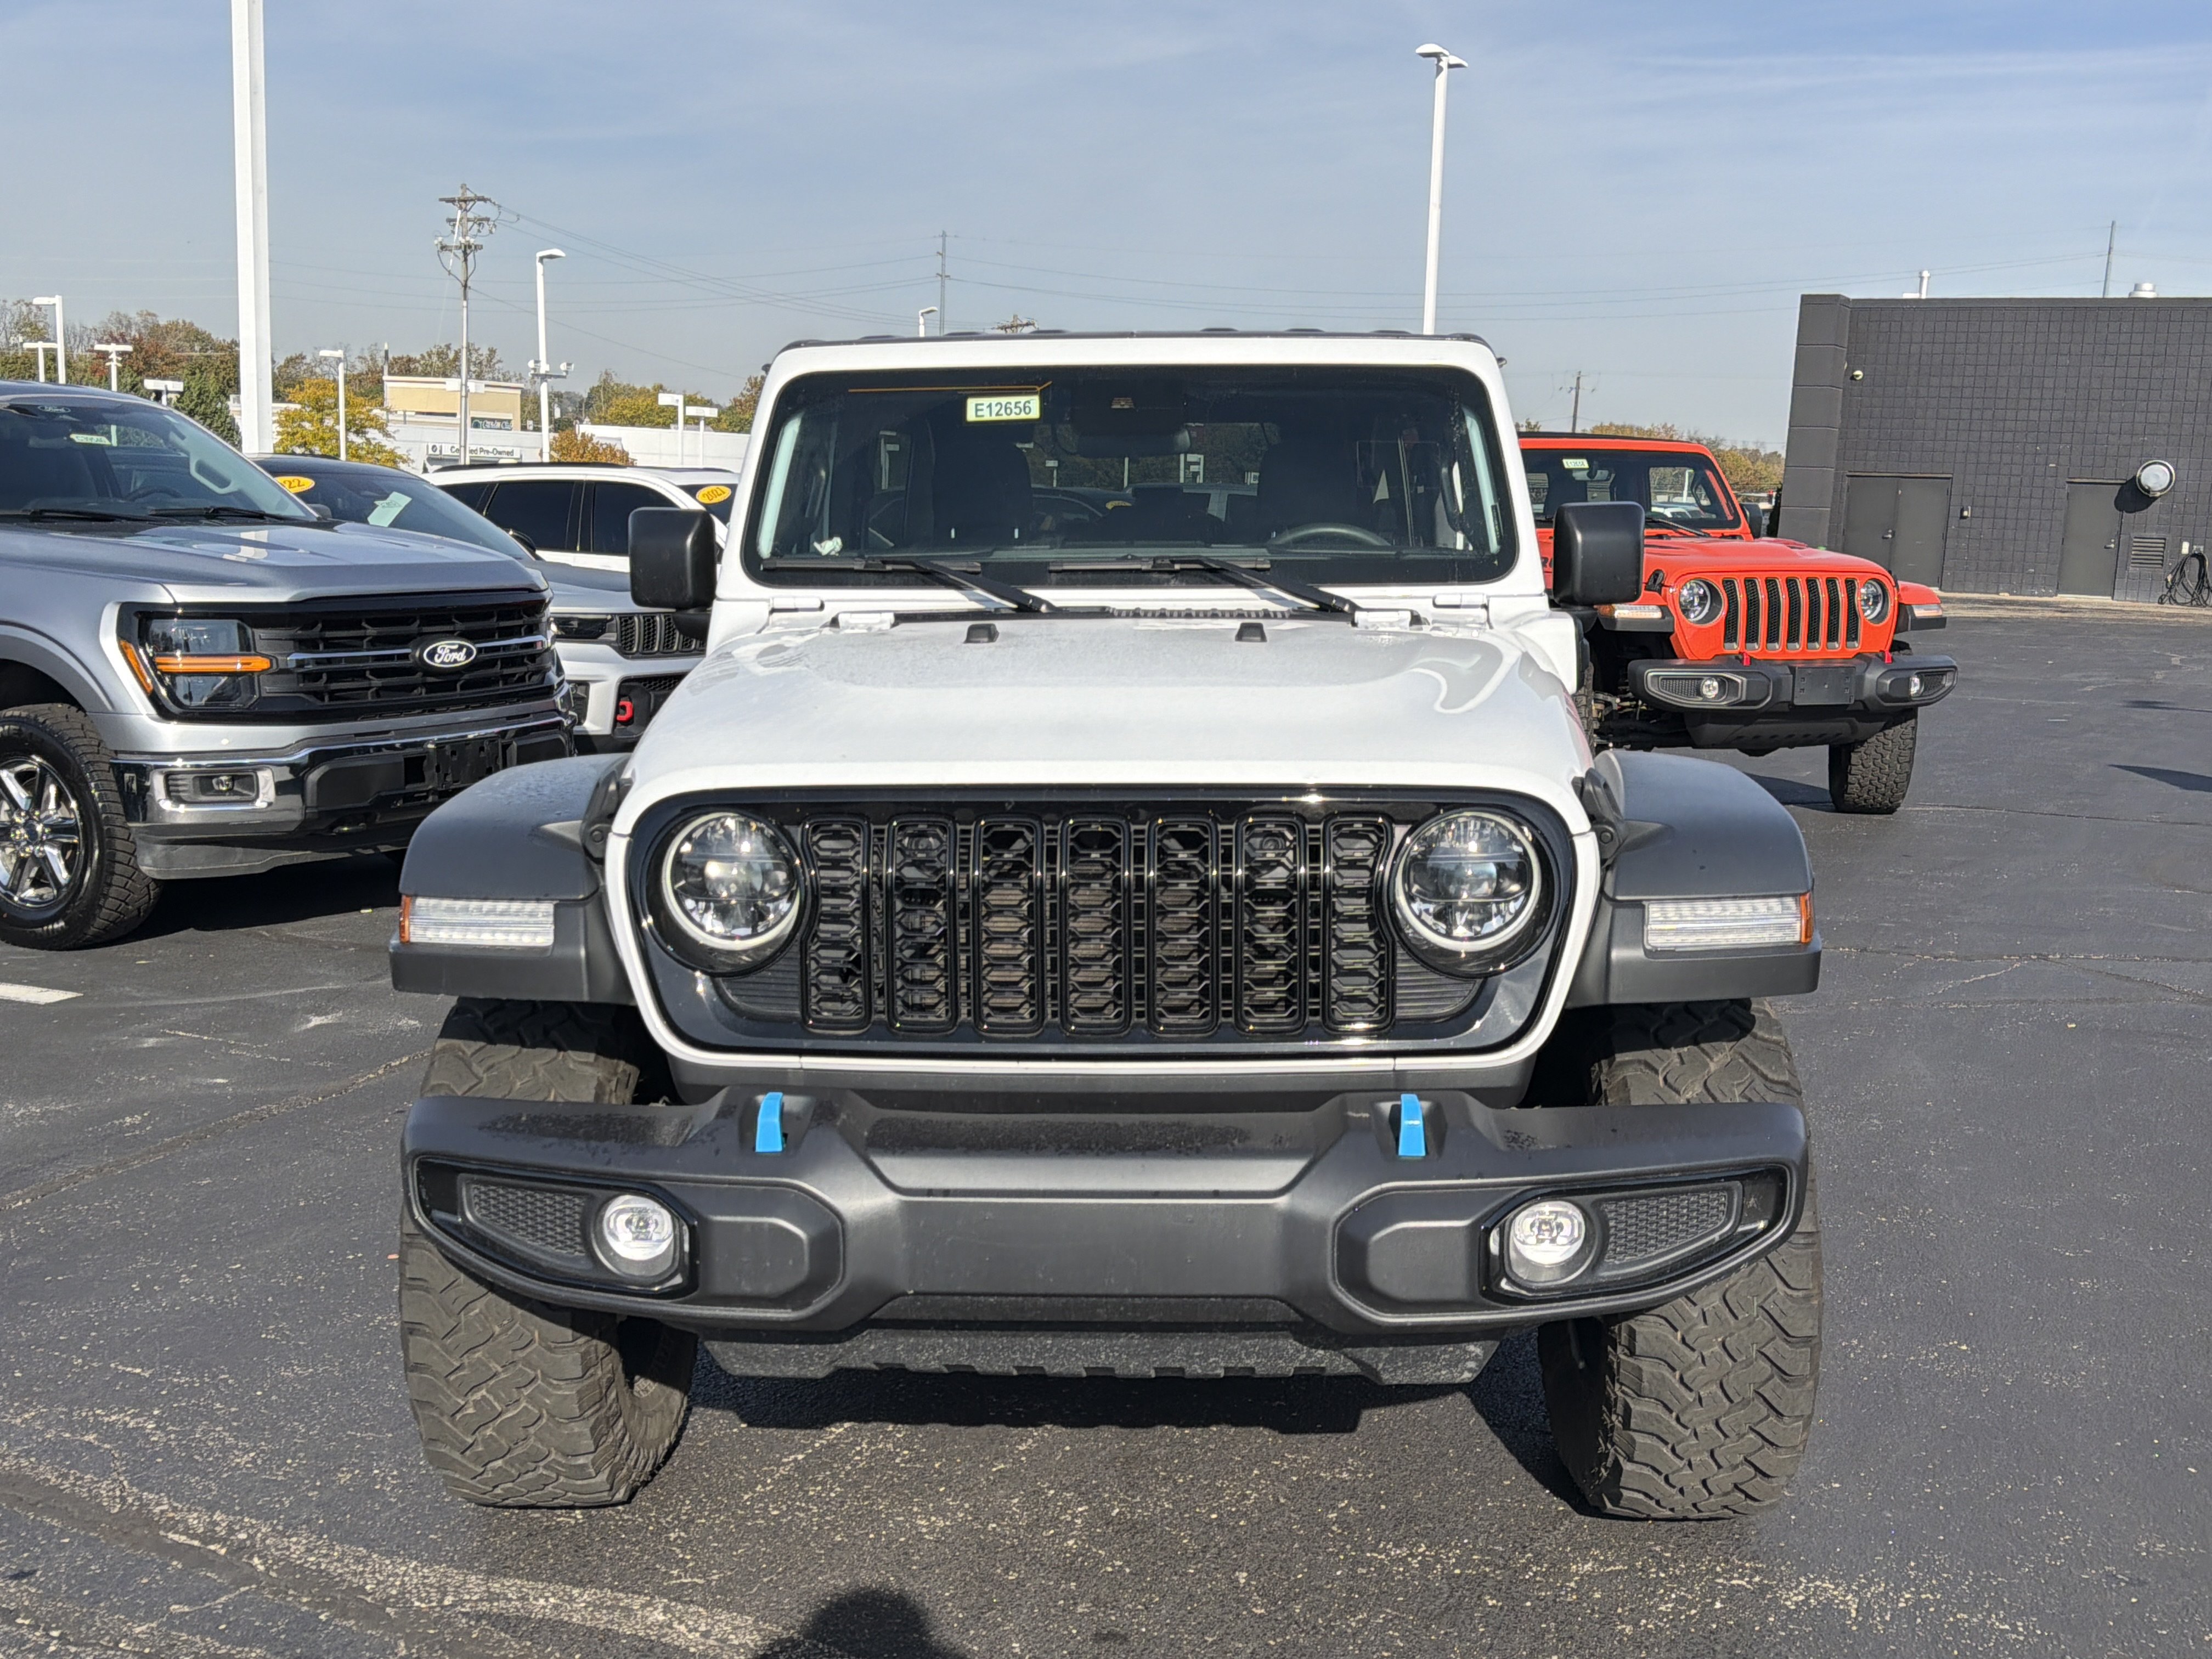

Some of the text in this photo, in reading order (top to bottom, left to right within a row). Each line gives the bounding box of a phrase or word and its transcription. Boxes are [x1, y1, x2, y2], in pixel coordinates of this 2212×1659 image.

[975, 400, 1032, 418] E12656
[450, 445, 514, 456] Ceied Pre-Owned
[282, 478, 305, 489] 22
[702, 487, 726, 501] 2021
[434, 644, 467, 663] Ford
